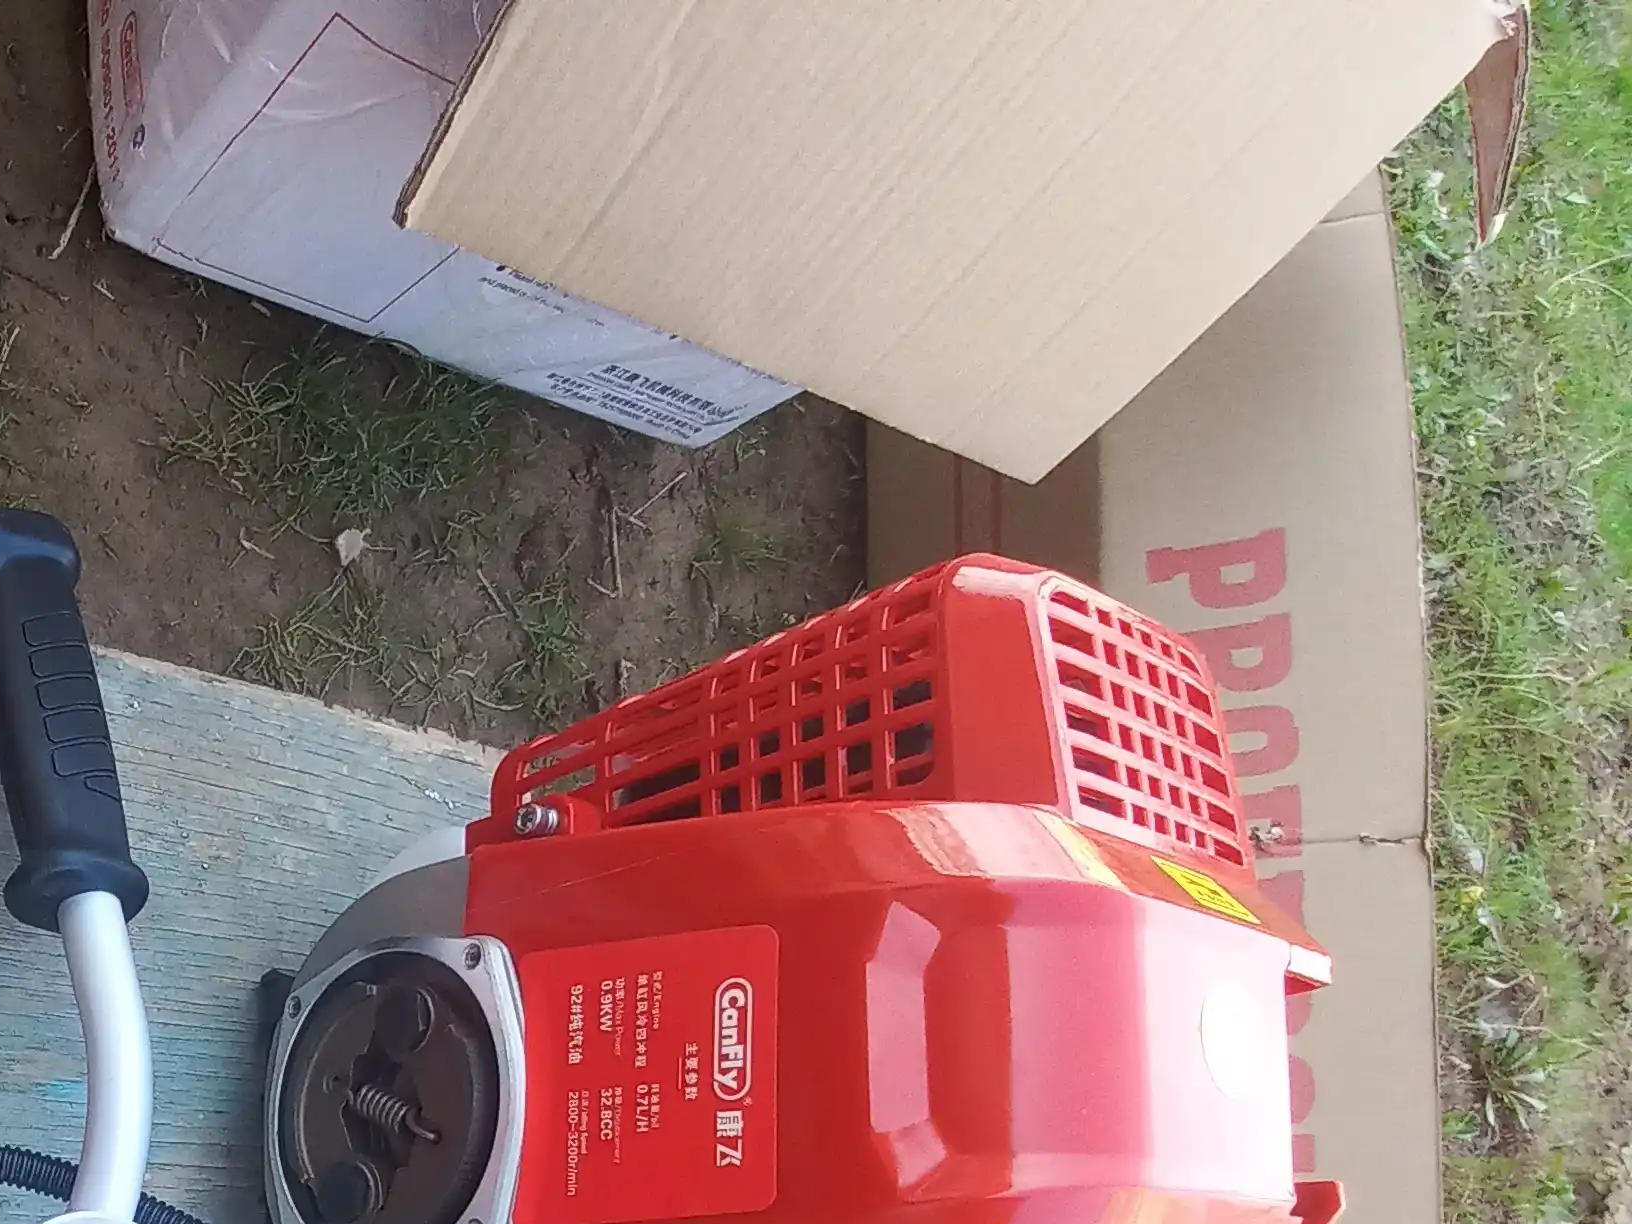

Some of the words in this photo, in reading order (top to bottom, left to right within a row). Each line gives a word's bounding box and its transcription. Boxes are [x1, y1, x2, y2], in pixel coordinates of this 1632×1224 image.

[600, 979, 613, 1032] 0.9KW
[714, 987, 746, 1091] CanFly
[600, 1087, 613, 1141] 32.8CC
[635, 1084, 649, 1133] 0.7L/H
[716, 1110, 744, 1167] 康飞
